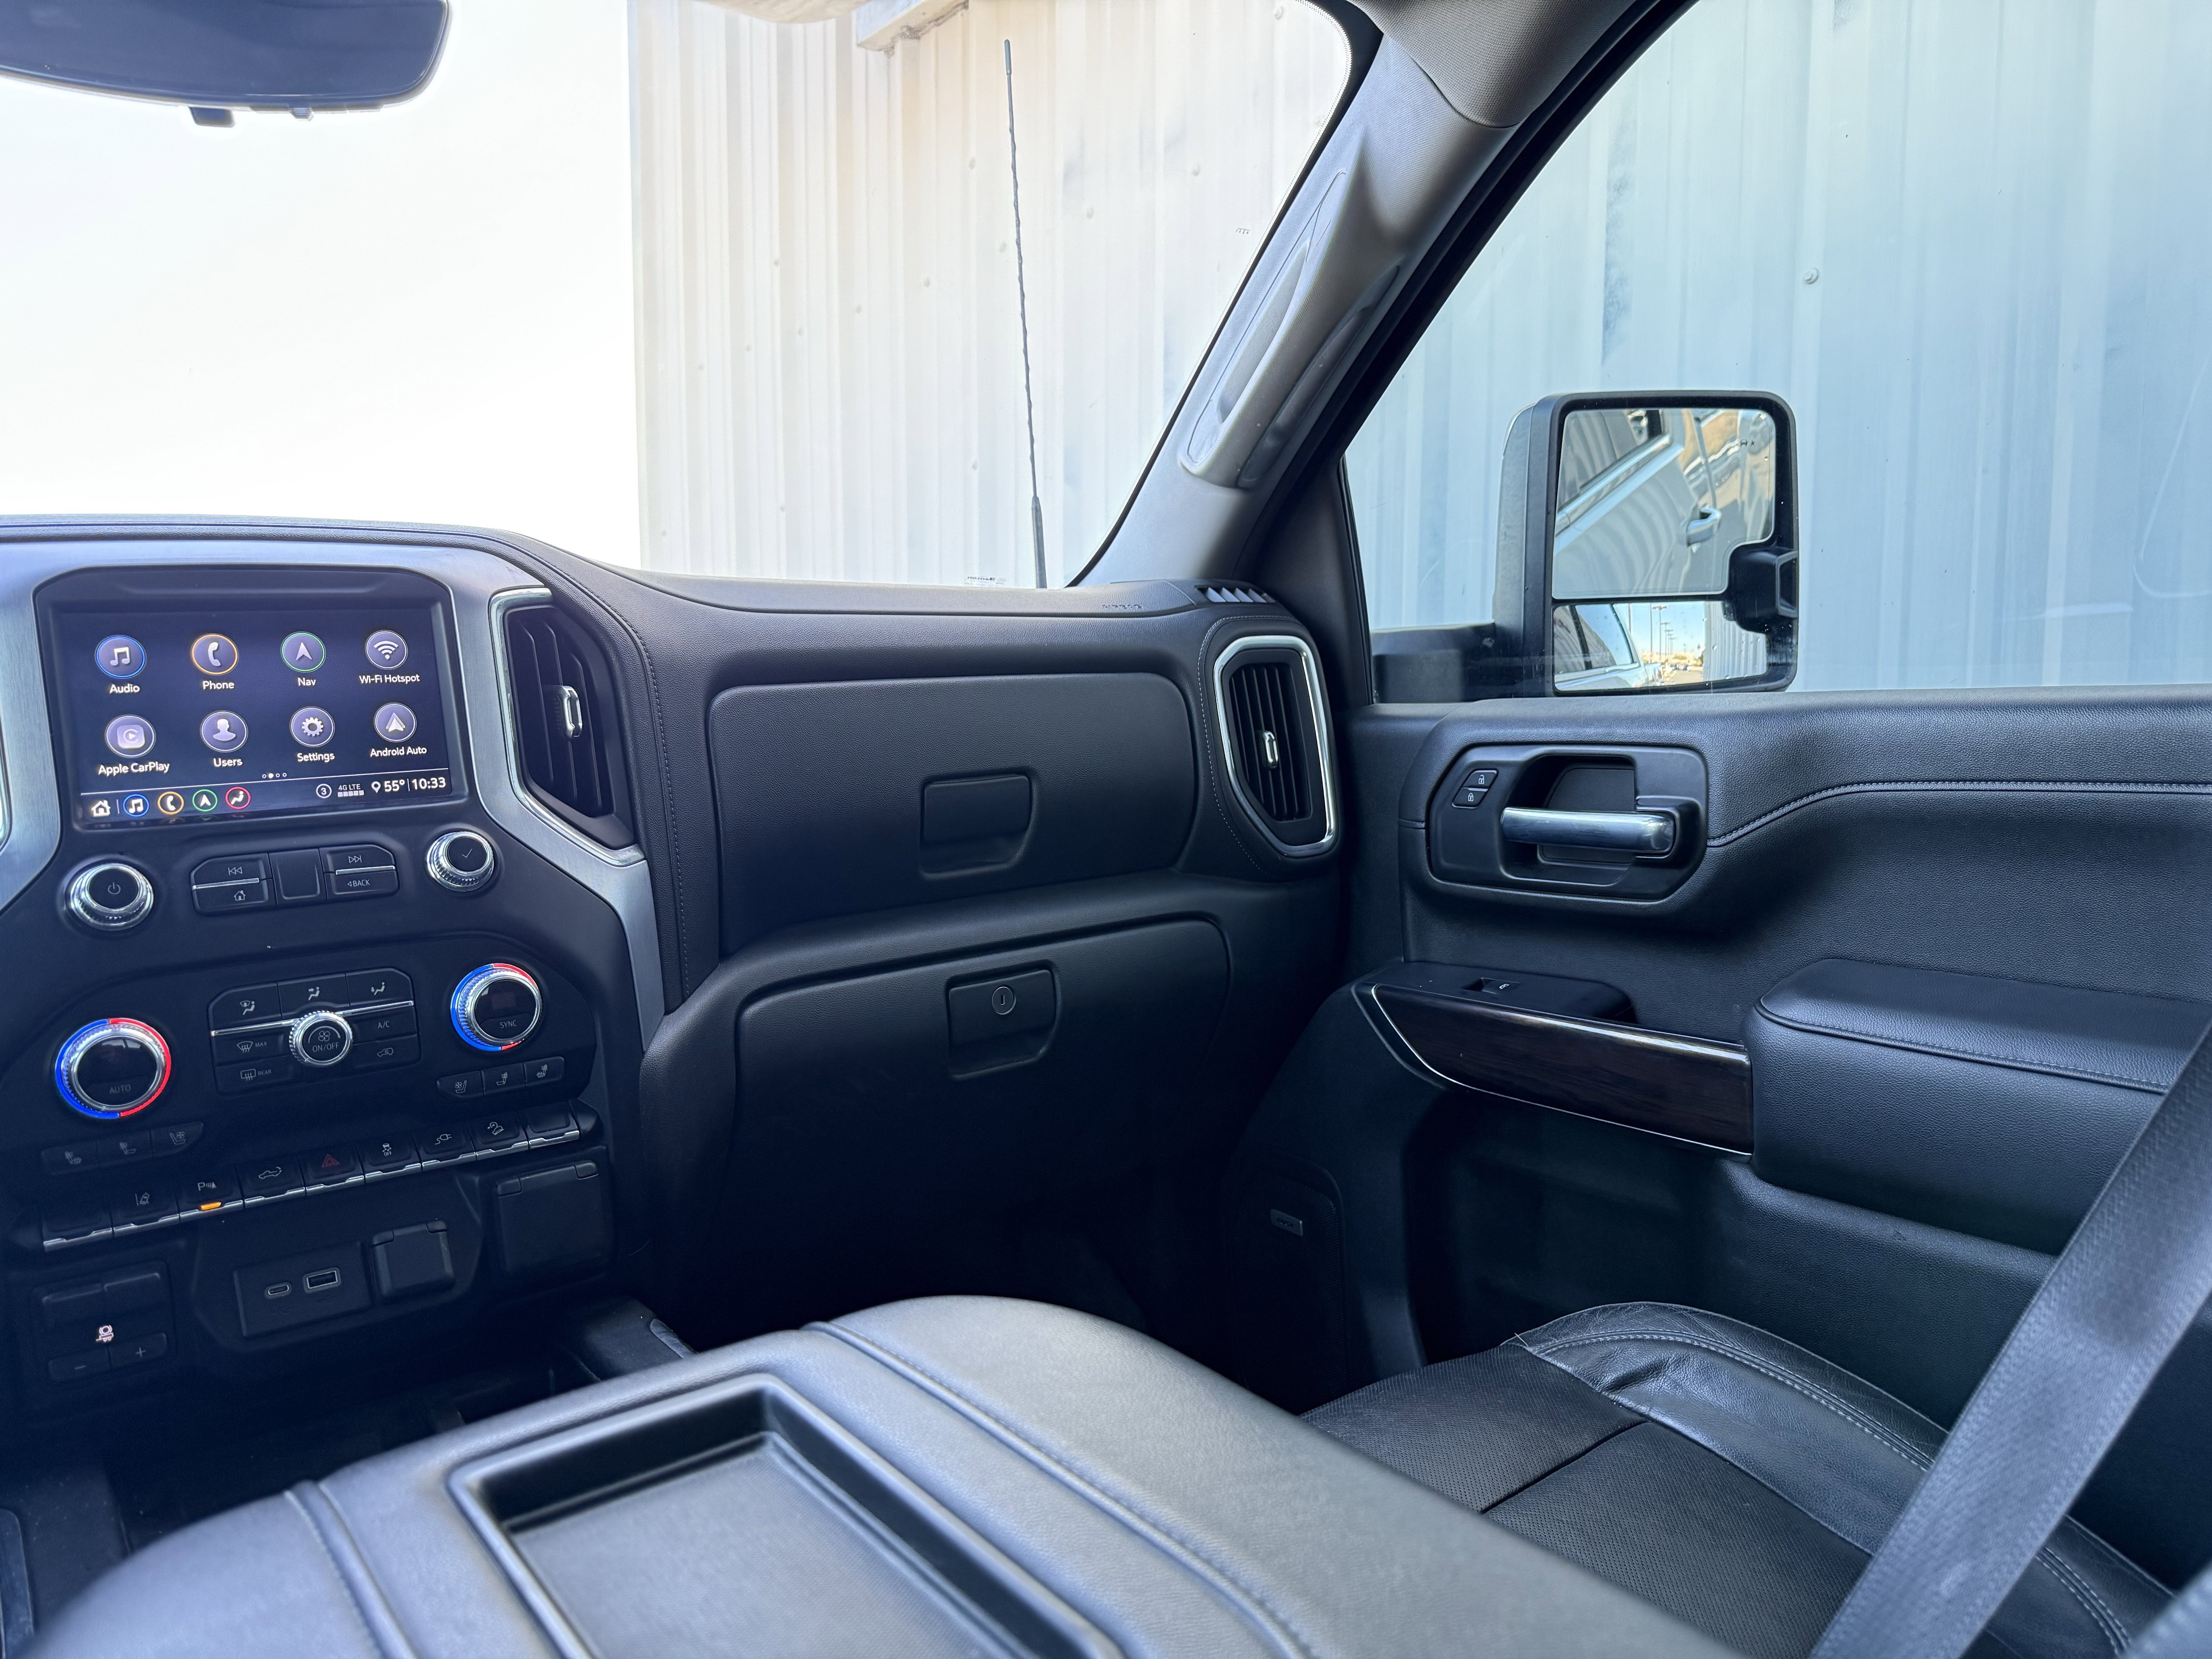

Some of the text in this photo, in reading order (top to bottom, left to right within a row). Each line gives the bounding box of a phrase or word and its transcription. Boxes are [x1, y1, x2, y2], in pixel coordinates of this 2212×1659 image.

[297, 677, 316, 686] Nav
[359, 674, 420, 684] Wi-Fi Hotspot
[109, 683, 140, 694] Audio
[203, 680, 235, 690] Phone
[370, 746, 427, 757] Android Auto
[213, 758, 243, 767] Users
[297, 752, 335, 763] Settings
[98, 761, 170, 776] Apple CarPlay
[384, 779, 405, 792] 55°
[412, 777, 446, 790] 10:33
[378, 1020, 390, 1029] A/C
[500, 1020, 517, 1029] SYNC
[312, 1042, 339, 1053] ON/OFF
[109, 1084, 131, 1094] AUTO
